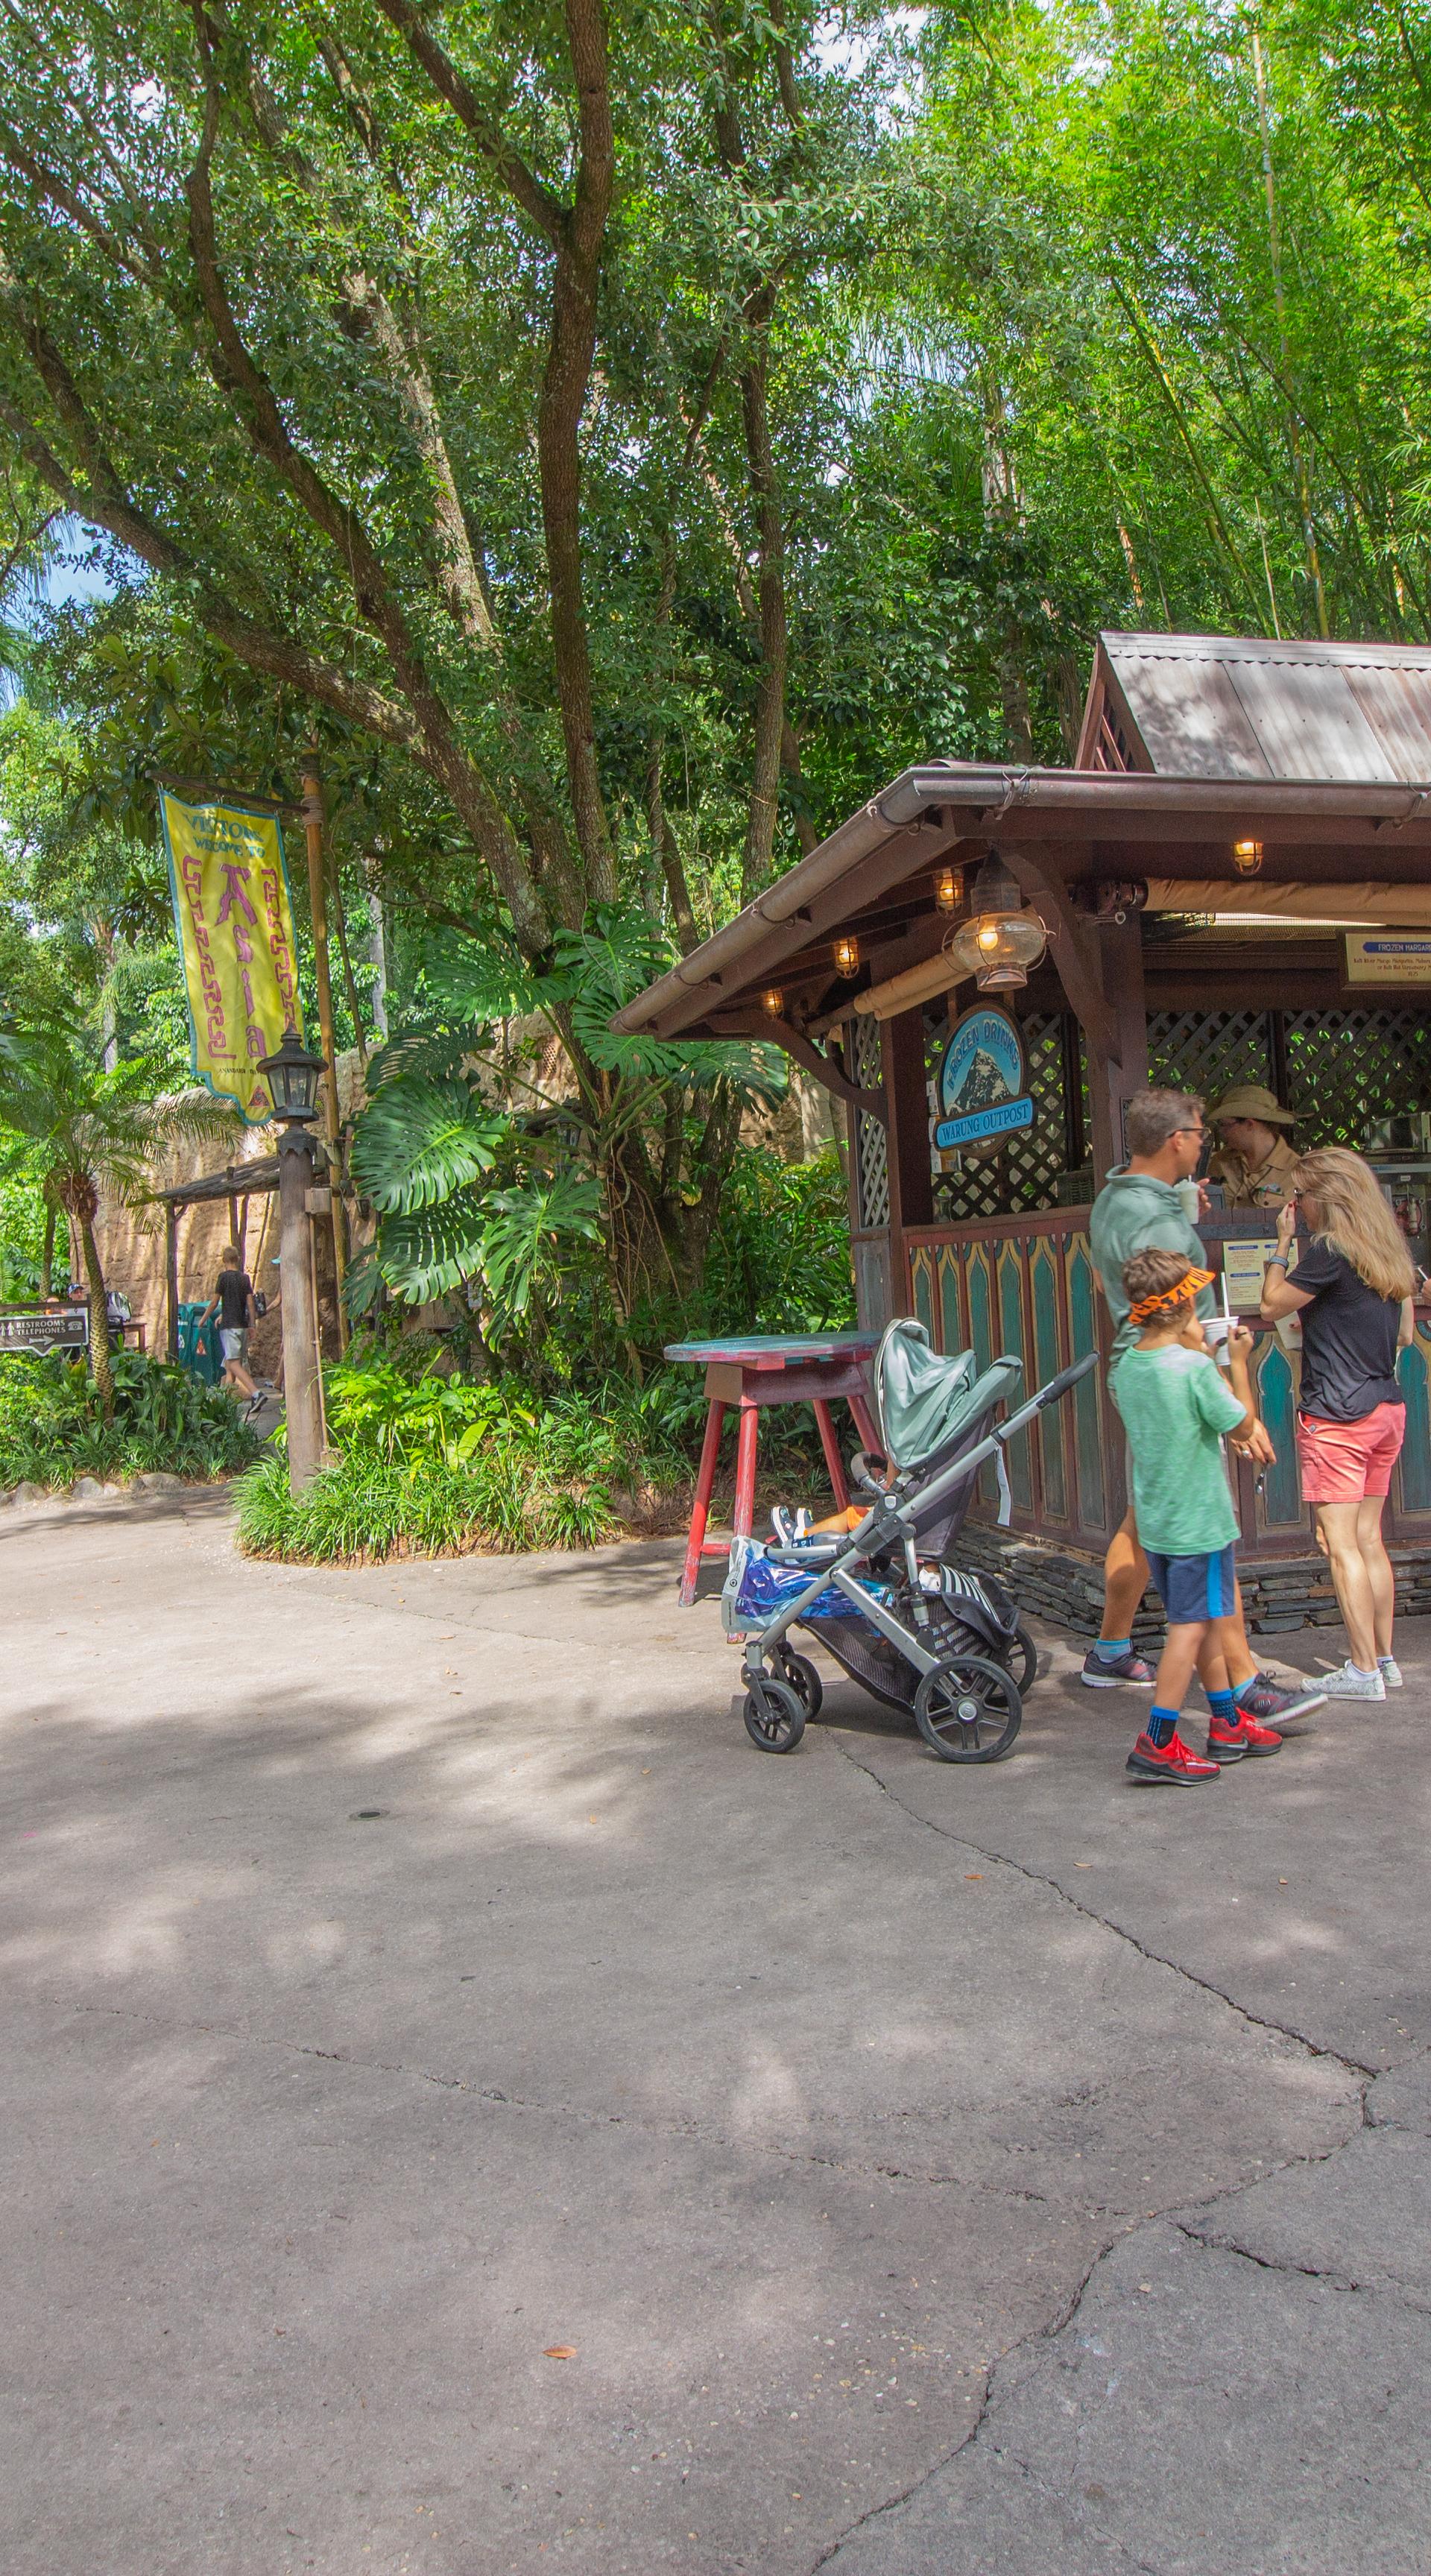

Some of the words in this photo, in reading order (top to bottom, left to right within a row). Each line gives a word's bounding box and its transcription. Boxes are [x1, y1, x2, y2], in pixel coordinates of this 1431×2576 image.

[246, 846, 265, 858] TO
[1378, 944, 1403, 952] FROZEN
[947, 1023, 979, 1090] FROZEN
[984, 1019, 1019, 1070] DRINKS
[942, 1117, 980, 1141] WARUNG
[982, 1104, 1029, 1130] OUTPOST
[16, 1320, 66, 1329] RESTROOMS
[16, 1327, 66, 1336] TELEPHONES
